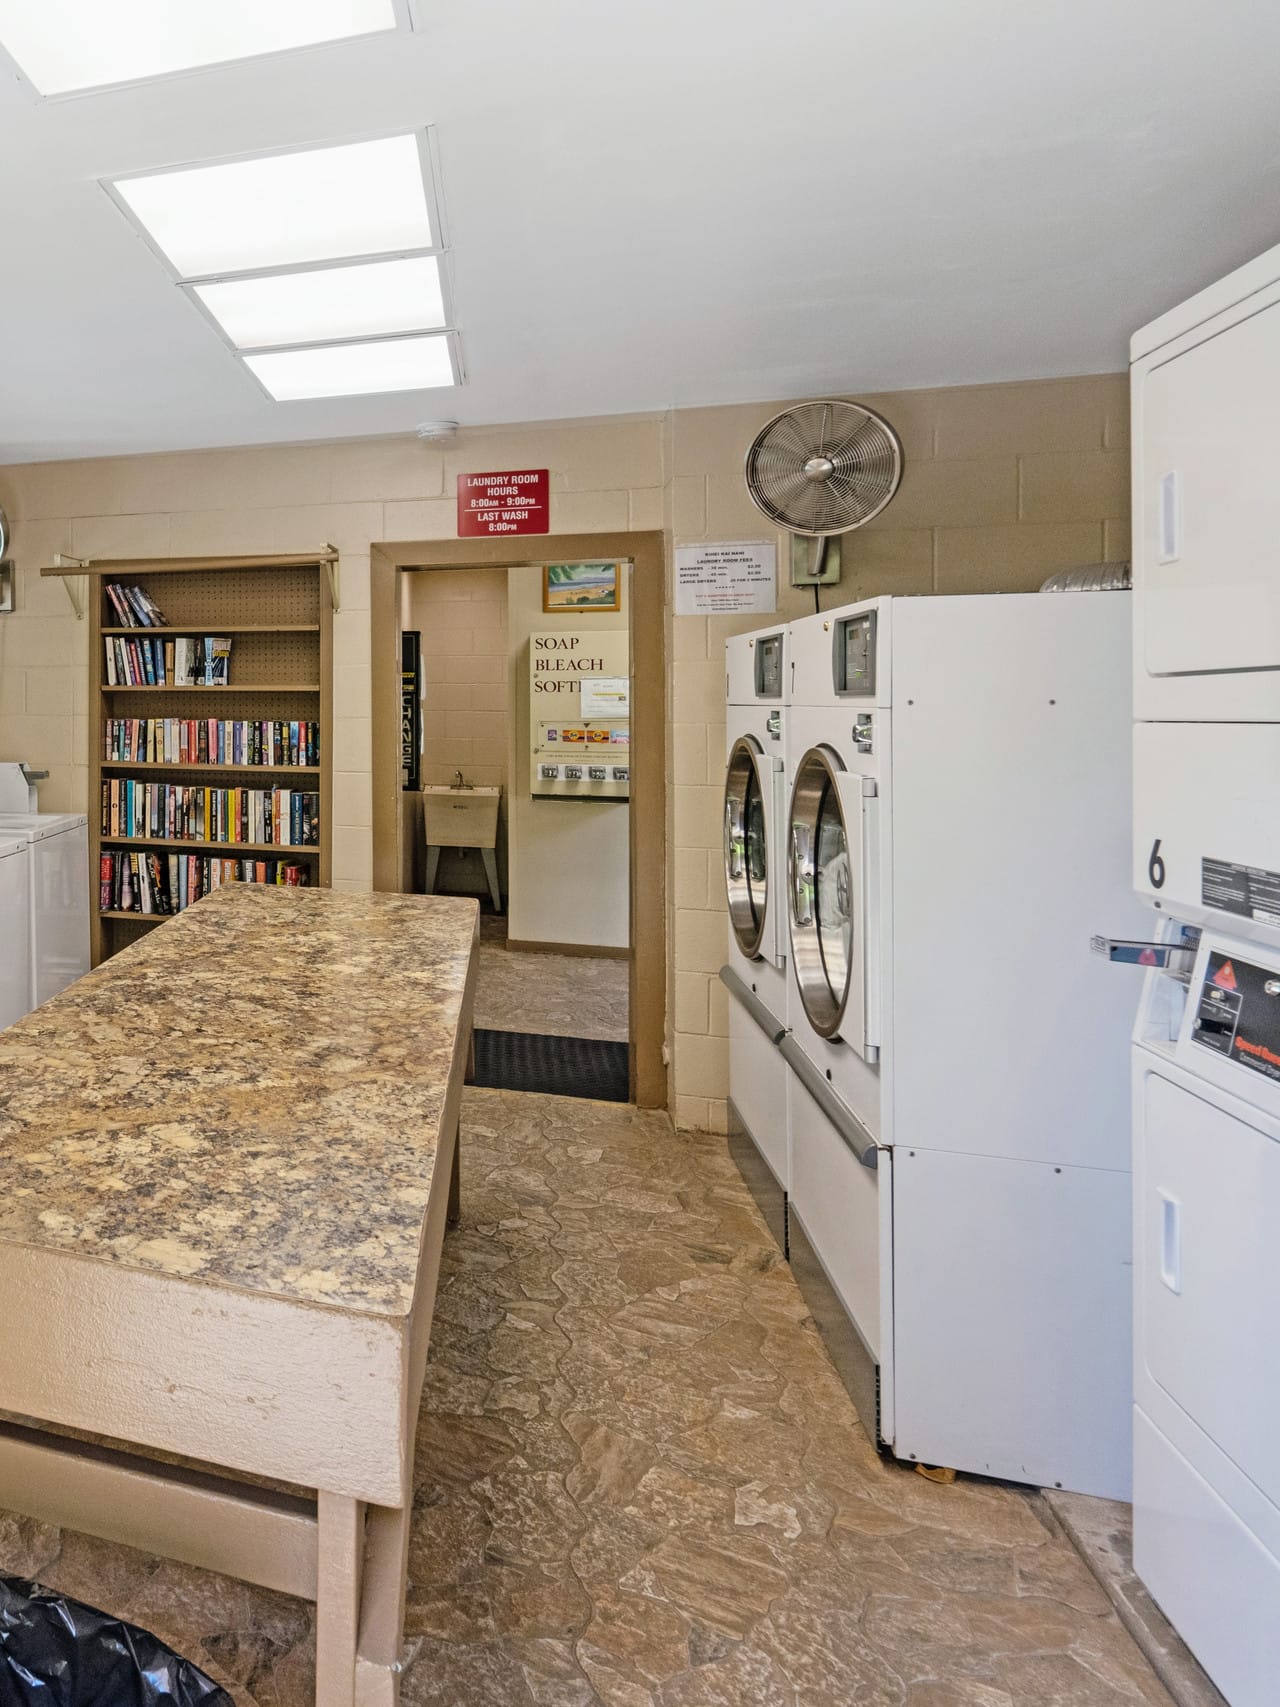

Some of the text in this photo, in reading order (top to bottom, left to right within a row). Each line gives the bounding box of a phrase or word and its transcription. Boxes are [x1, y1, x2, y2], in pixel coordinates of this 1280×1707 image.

[468, 474, 538, 486] LAUNDRY ROOM
[488, 486, 518, 496] HOURS
[471, 499, 499, 508] 8:00AM
[506, 497, 536, 506] 9:00PM
[478, 511, 528, 522] LAST WASH
[488, 522, 516, 531] 8:00PM
[535, 638, 580, 650] SOAP
[535, 659, 603, 672] BLEACH
[1149, 839, 1165, 888] 6
